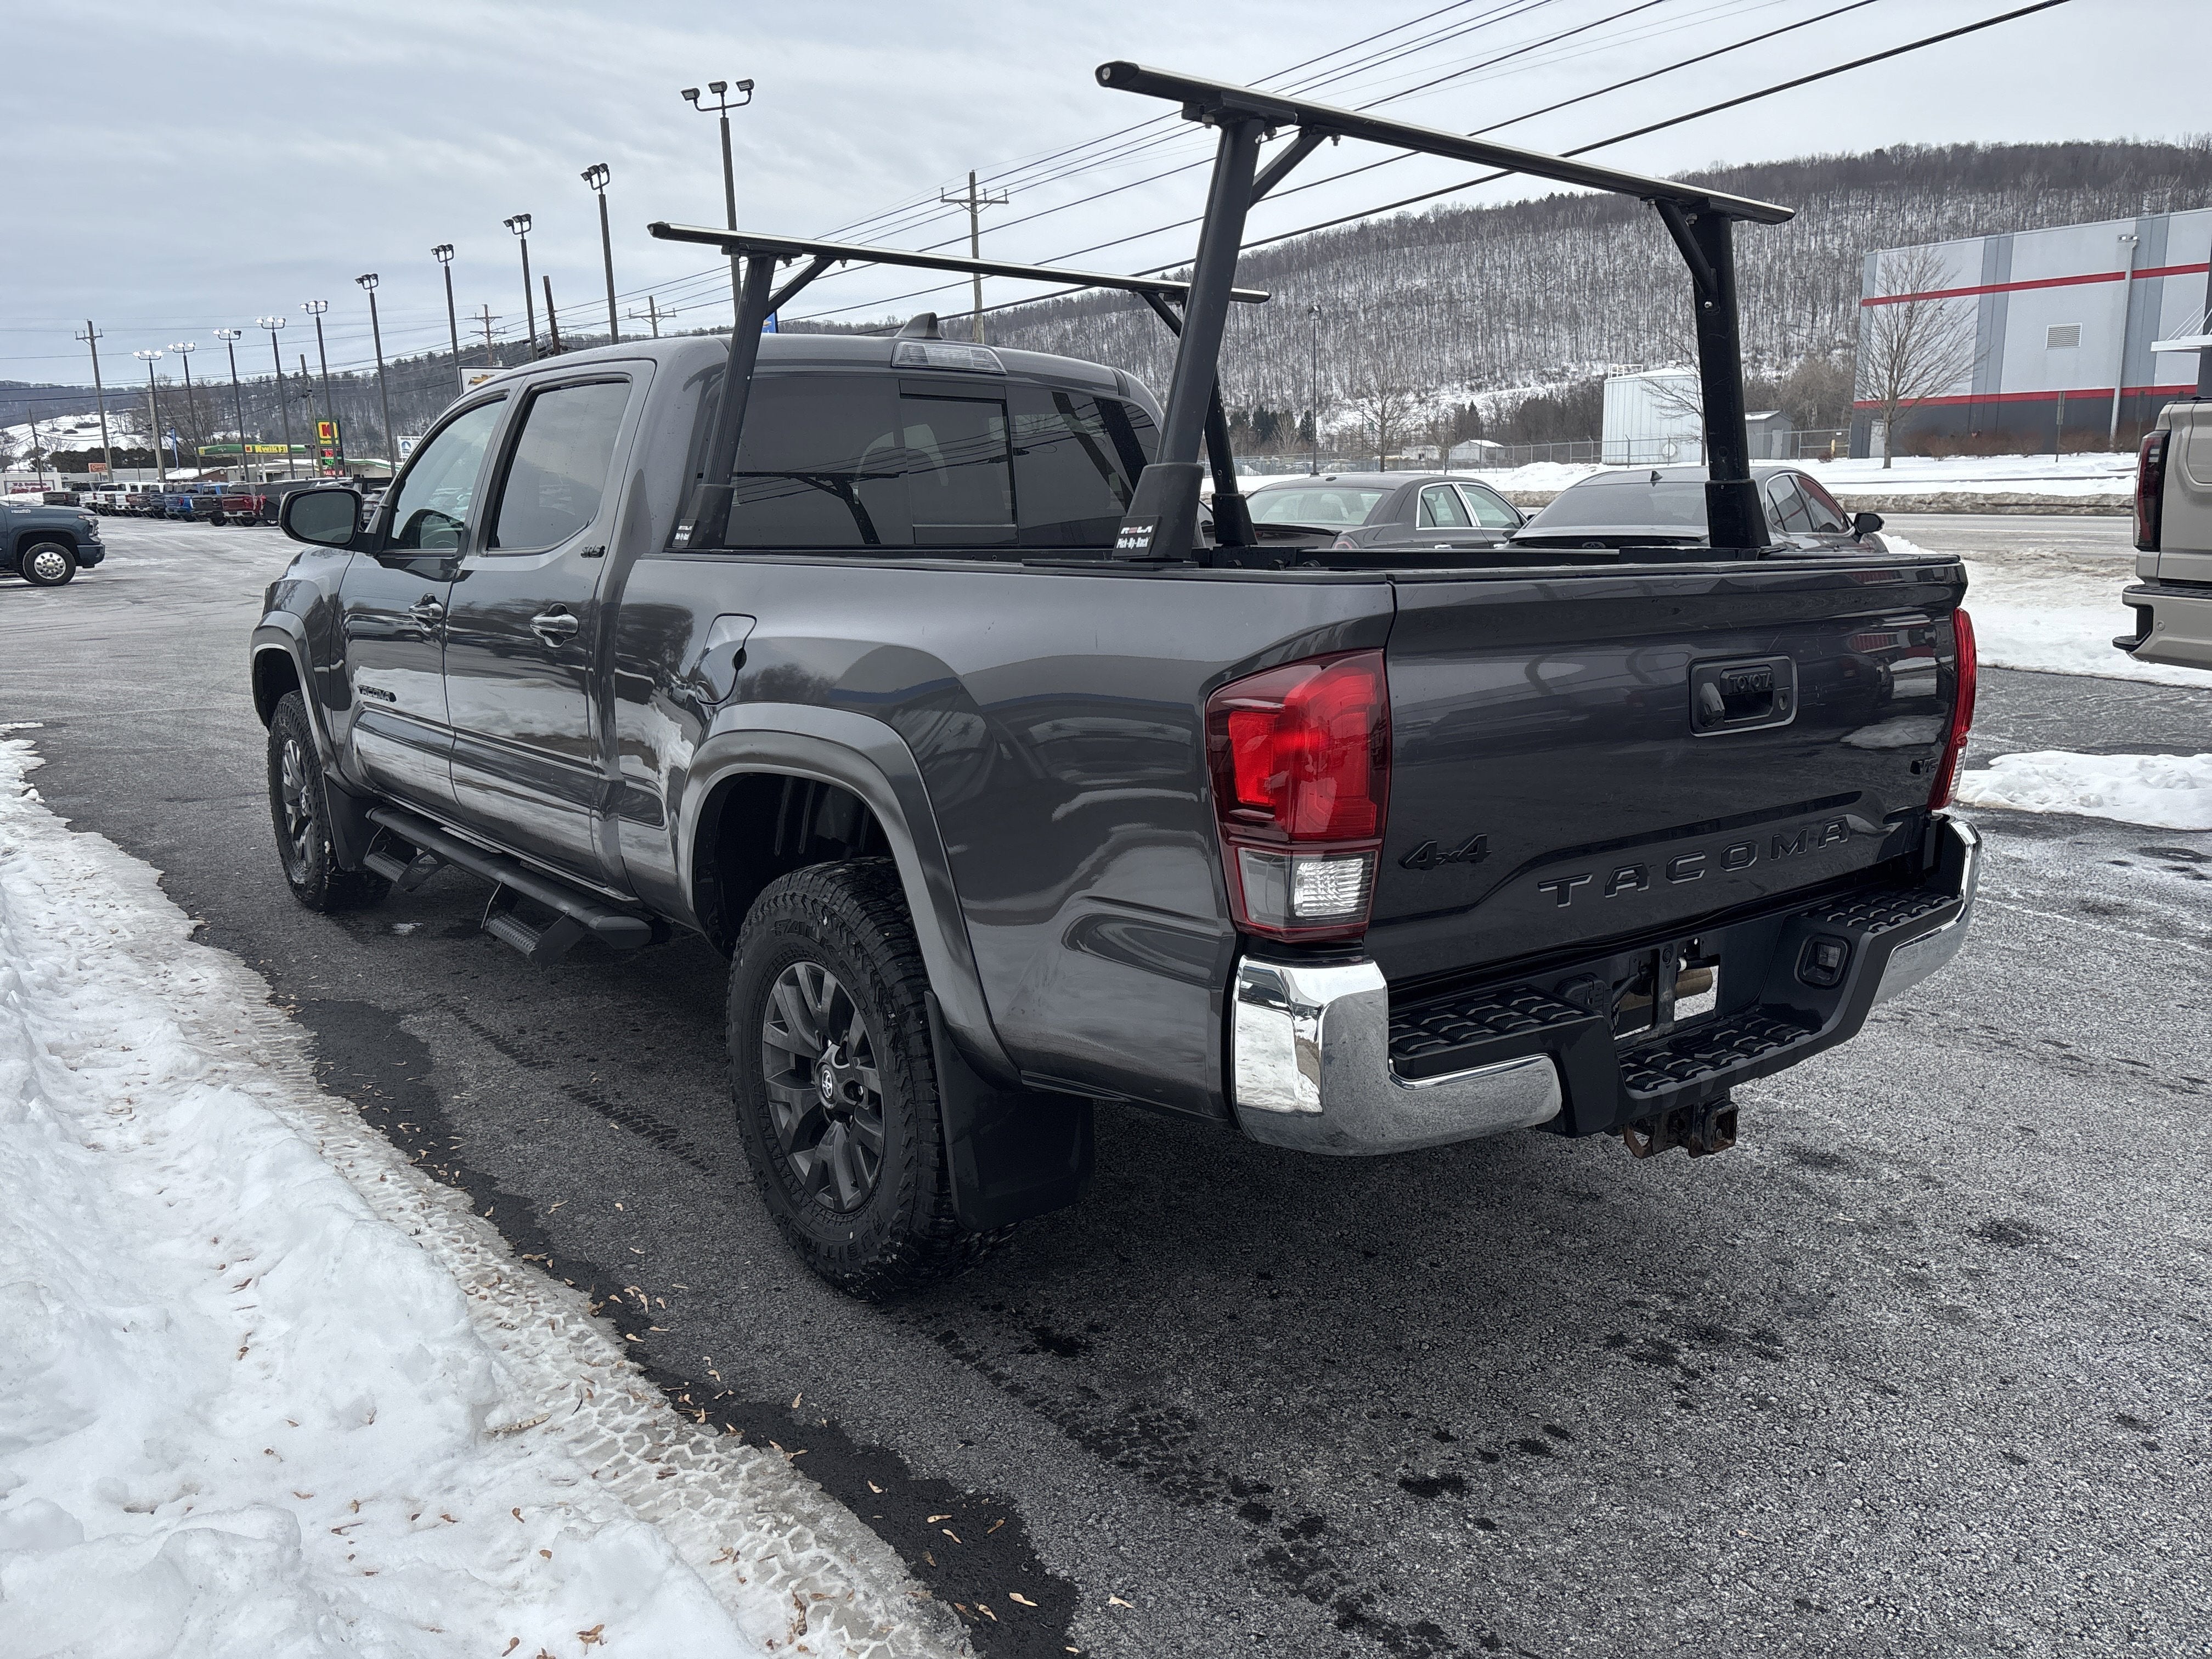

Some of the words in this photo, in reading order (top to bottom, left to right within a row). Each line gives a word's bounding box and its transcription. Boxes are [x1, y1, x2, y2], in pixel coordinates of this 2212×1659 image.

[255, 445, 278, 453] Kwik
[357, 684, 391, 702] TACOMA
[1729, 672, 1774, 695] TOYOTA
[1398, 833, 1492, 871] 4x4
[1537, 814, 1850, 909] TACOMA
